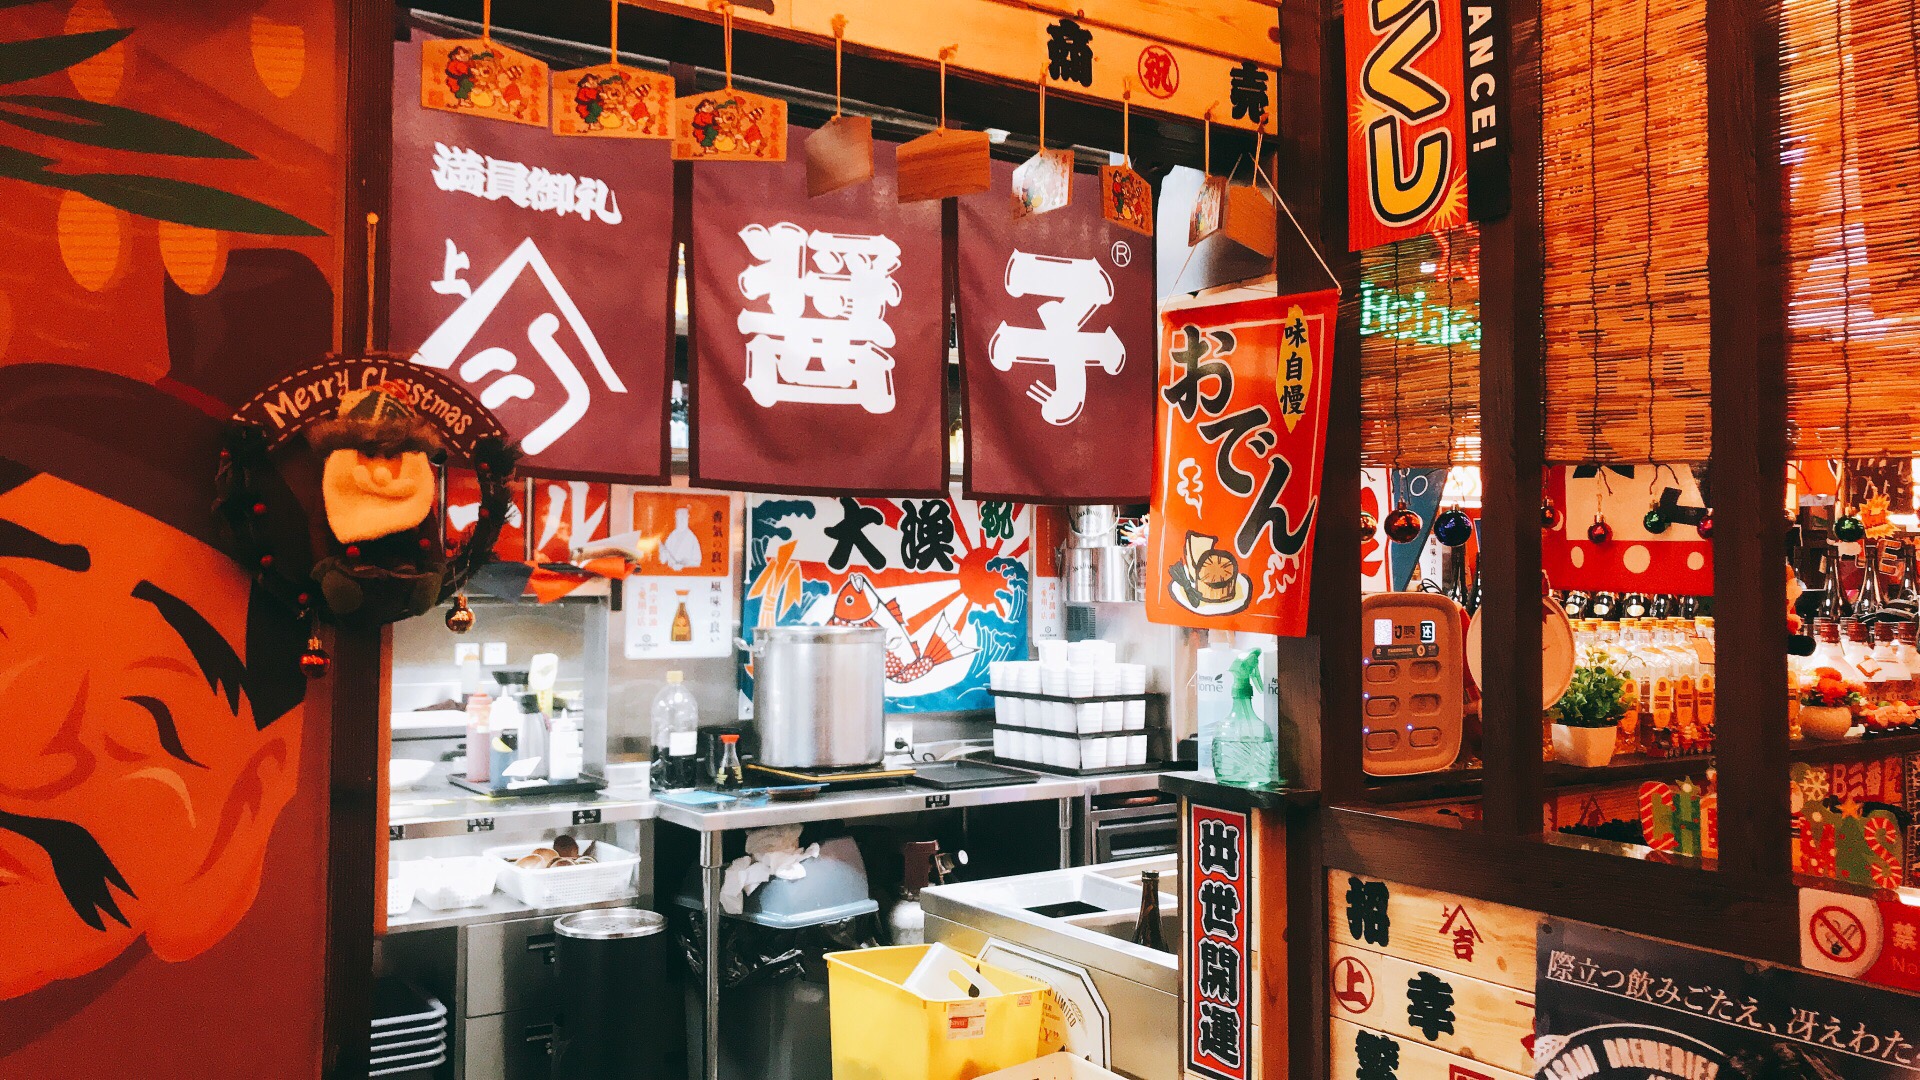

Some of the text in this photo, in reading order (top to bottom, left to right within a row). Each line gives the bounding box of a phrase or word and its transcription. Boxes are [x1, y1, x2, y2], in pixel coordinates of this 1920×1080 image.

[1142, 47, 1175, 94] 祝
[1468, 6, 1497, 153] ANCE!
[430, 238, 472, 299] 上
[988, 248, 1126, 427] 子
[1280, 317, 1307, 415] 味自慢
[263, 369, 349, 429] Merry
[361, 366, 473, 436] Cistmas
[1161, 322, 1318, 558] おでん
[1198, 684, 1224, 693] ome
[1198, 818, 1240, 1069] 出世開運
[1346, 876, 1390, 947] 招
[1893, 921, 1918, 951] 禁
[1054, 991, 1077, 1028] LIMITED
[1335, 958, 1372, 1010] 上
[1407, 971, 1456, 1041] 幸
